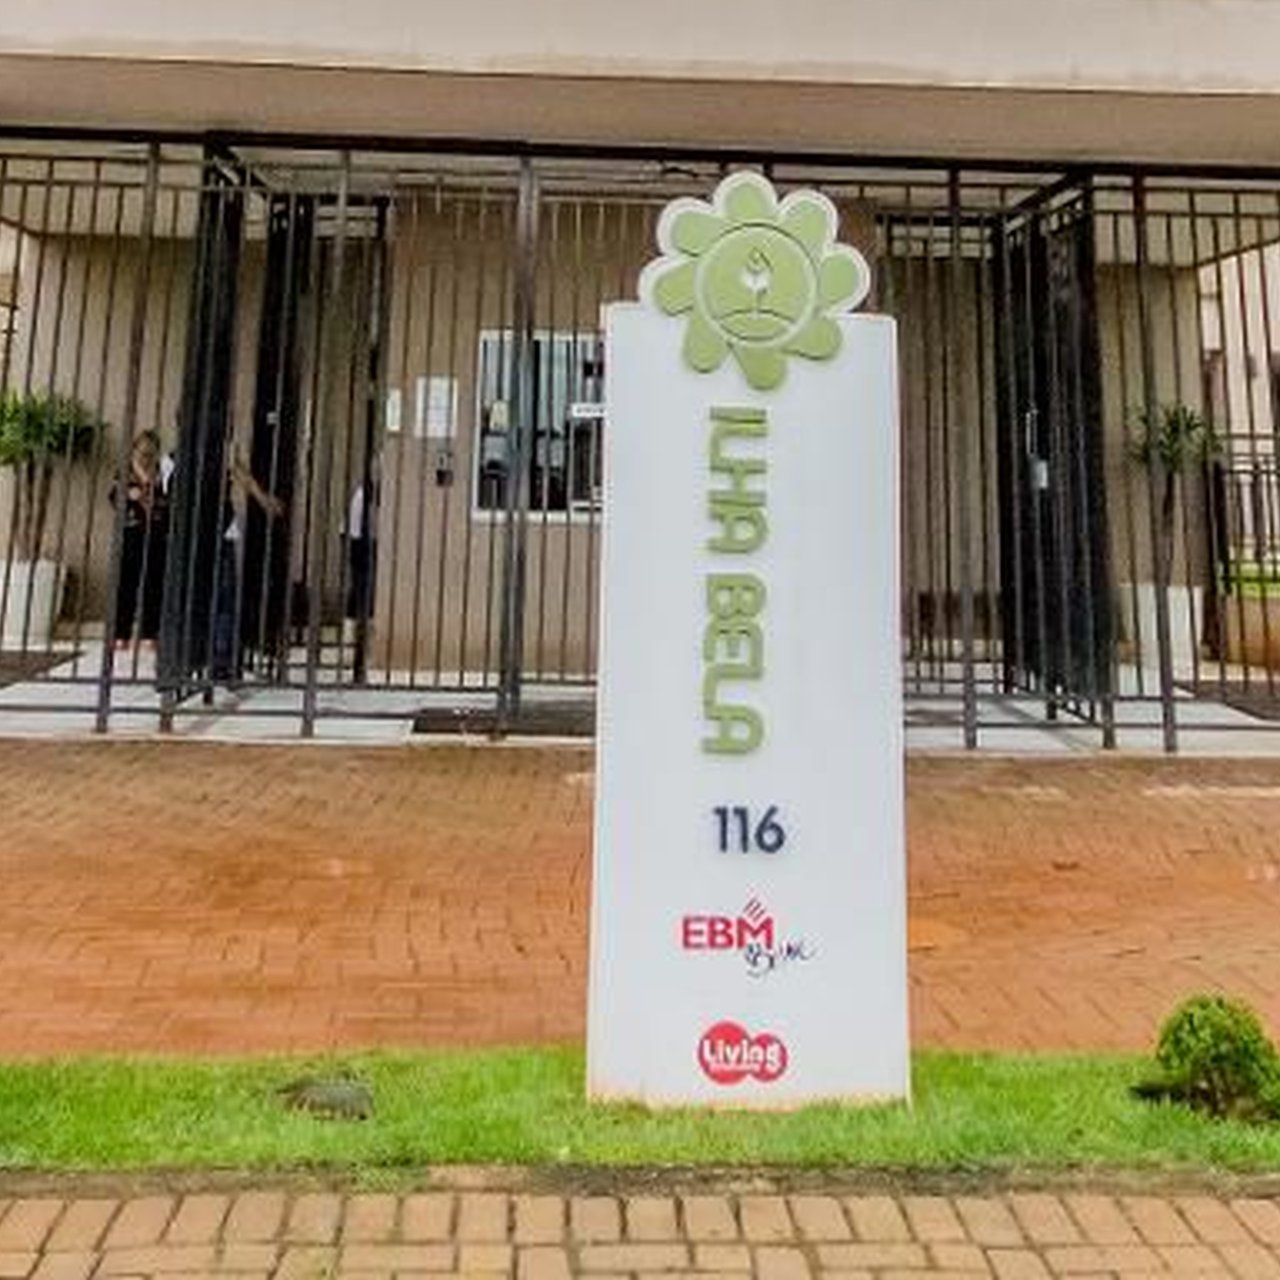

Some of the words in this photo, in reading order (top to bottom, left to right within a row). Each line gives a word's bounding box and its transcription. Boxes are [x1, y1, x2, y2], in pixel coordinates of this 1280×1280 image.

[708, 406, 768, 554] ILHA
[702, 572, 768, 755] BELA
[712, 805, 786, 854] 116
[682, 916, 774, 950] EBM
[703, 1038, 782, 1071] Living
